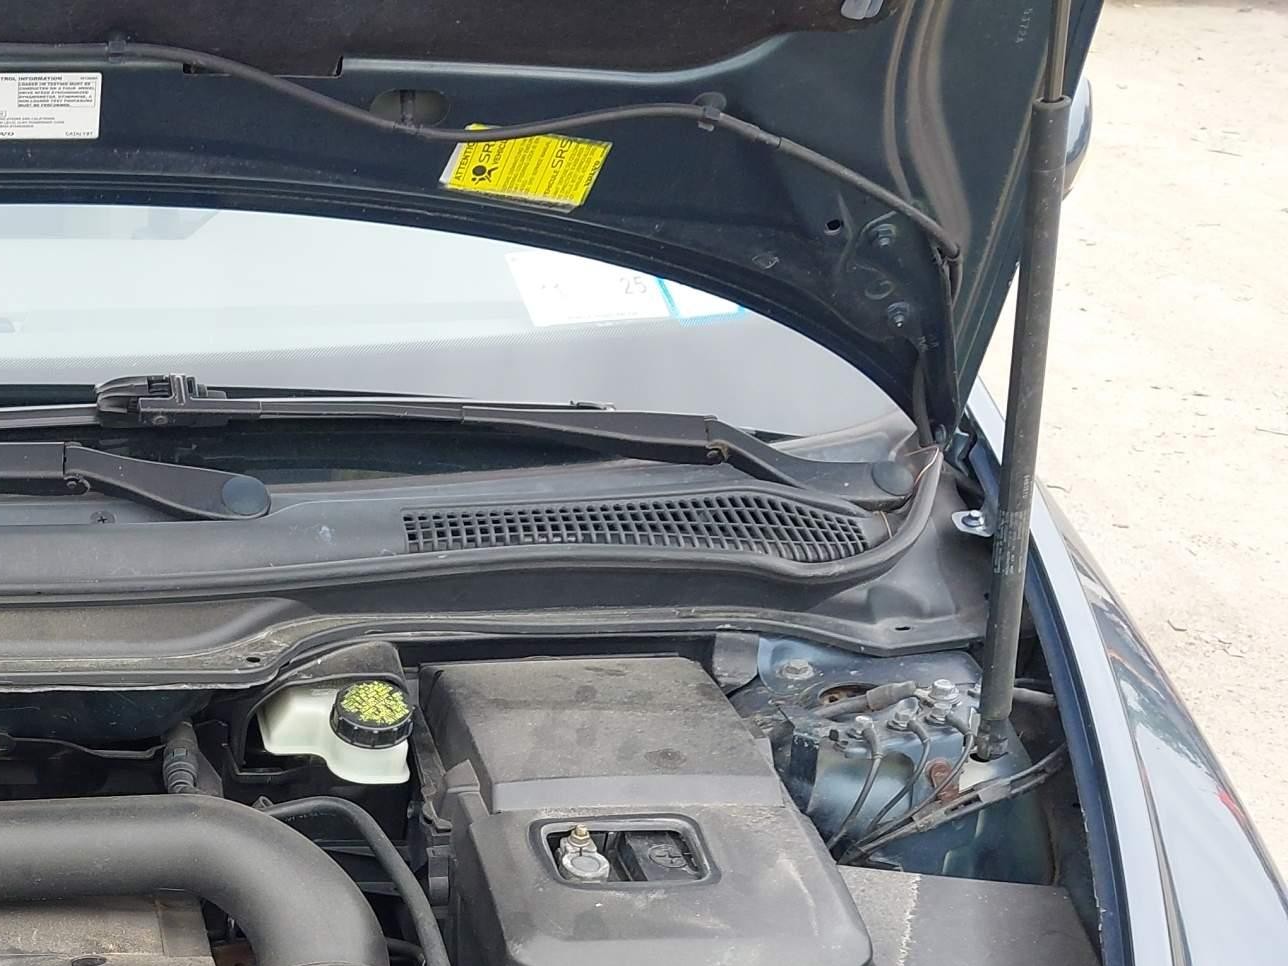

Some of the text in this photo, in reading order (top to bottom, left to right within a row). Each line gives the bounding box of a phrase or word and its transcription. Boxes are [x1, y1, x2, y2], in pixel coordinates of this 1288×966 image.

[455, 142, 475, 181] ATTENTIO
[478, 142, 496, 164] SR
[552, 139, 573, 169] SRS
